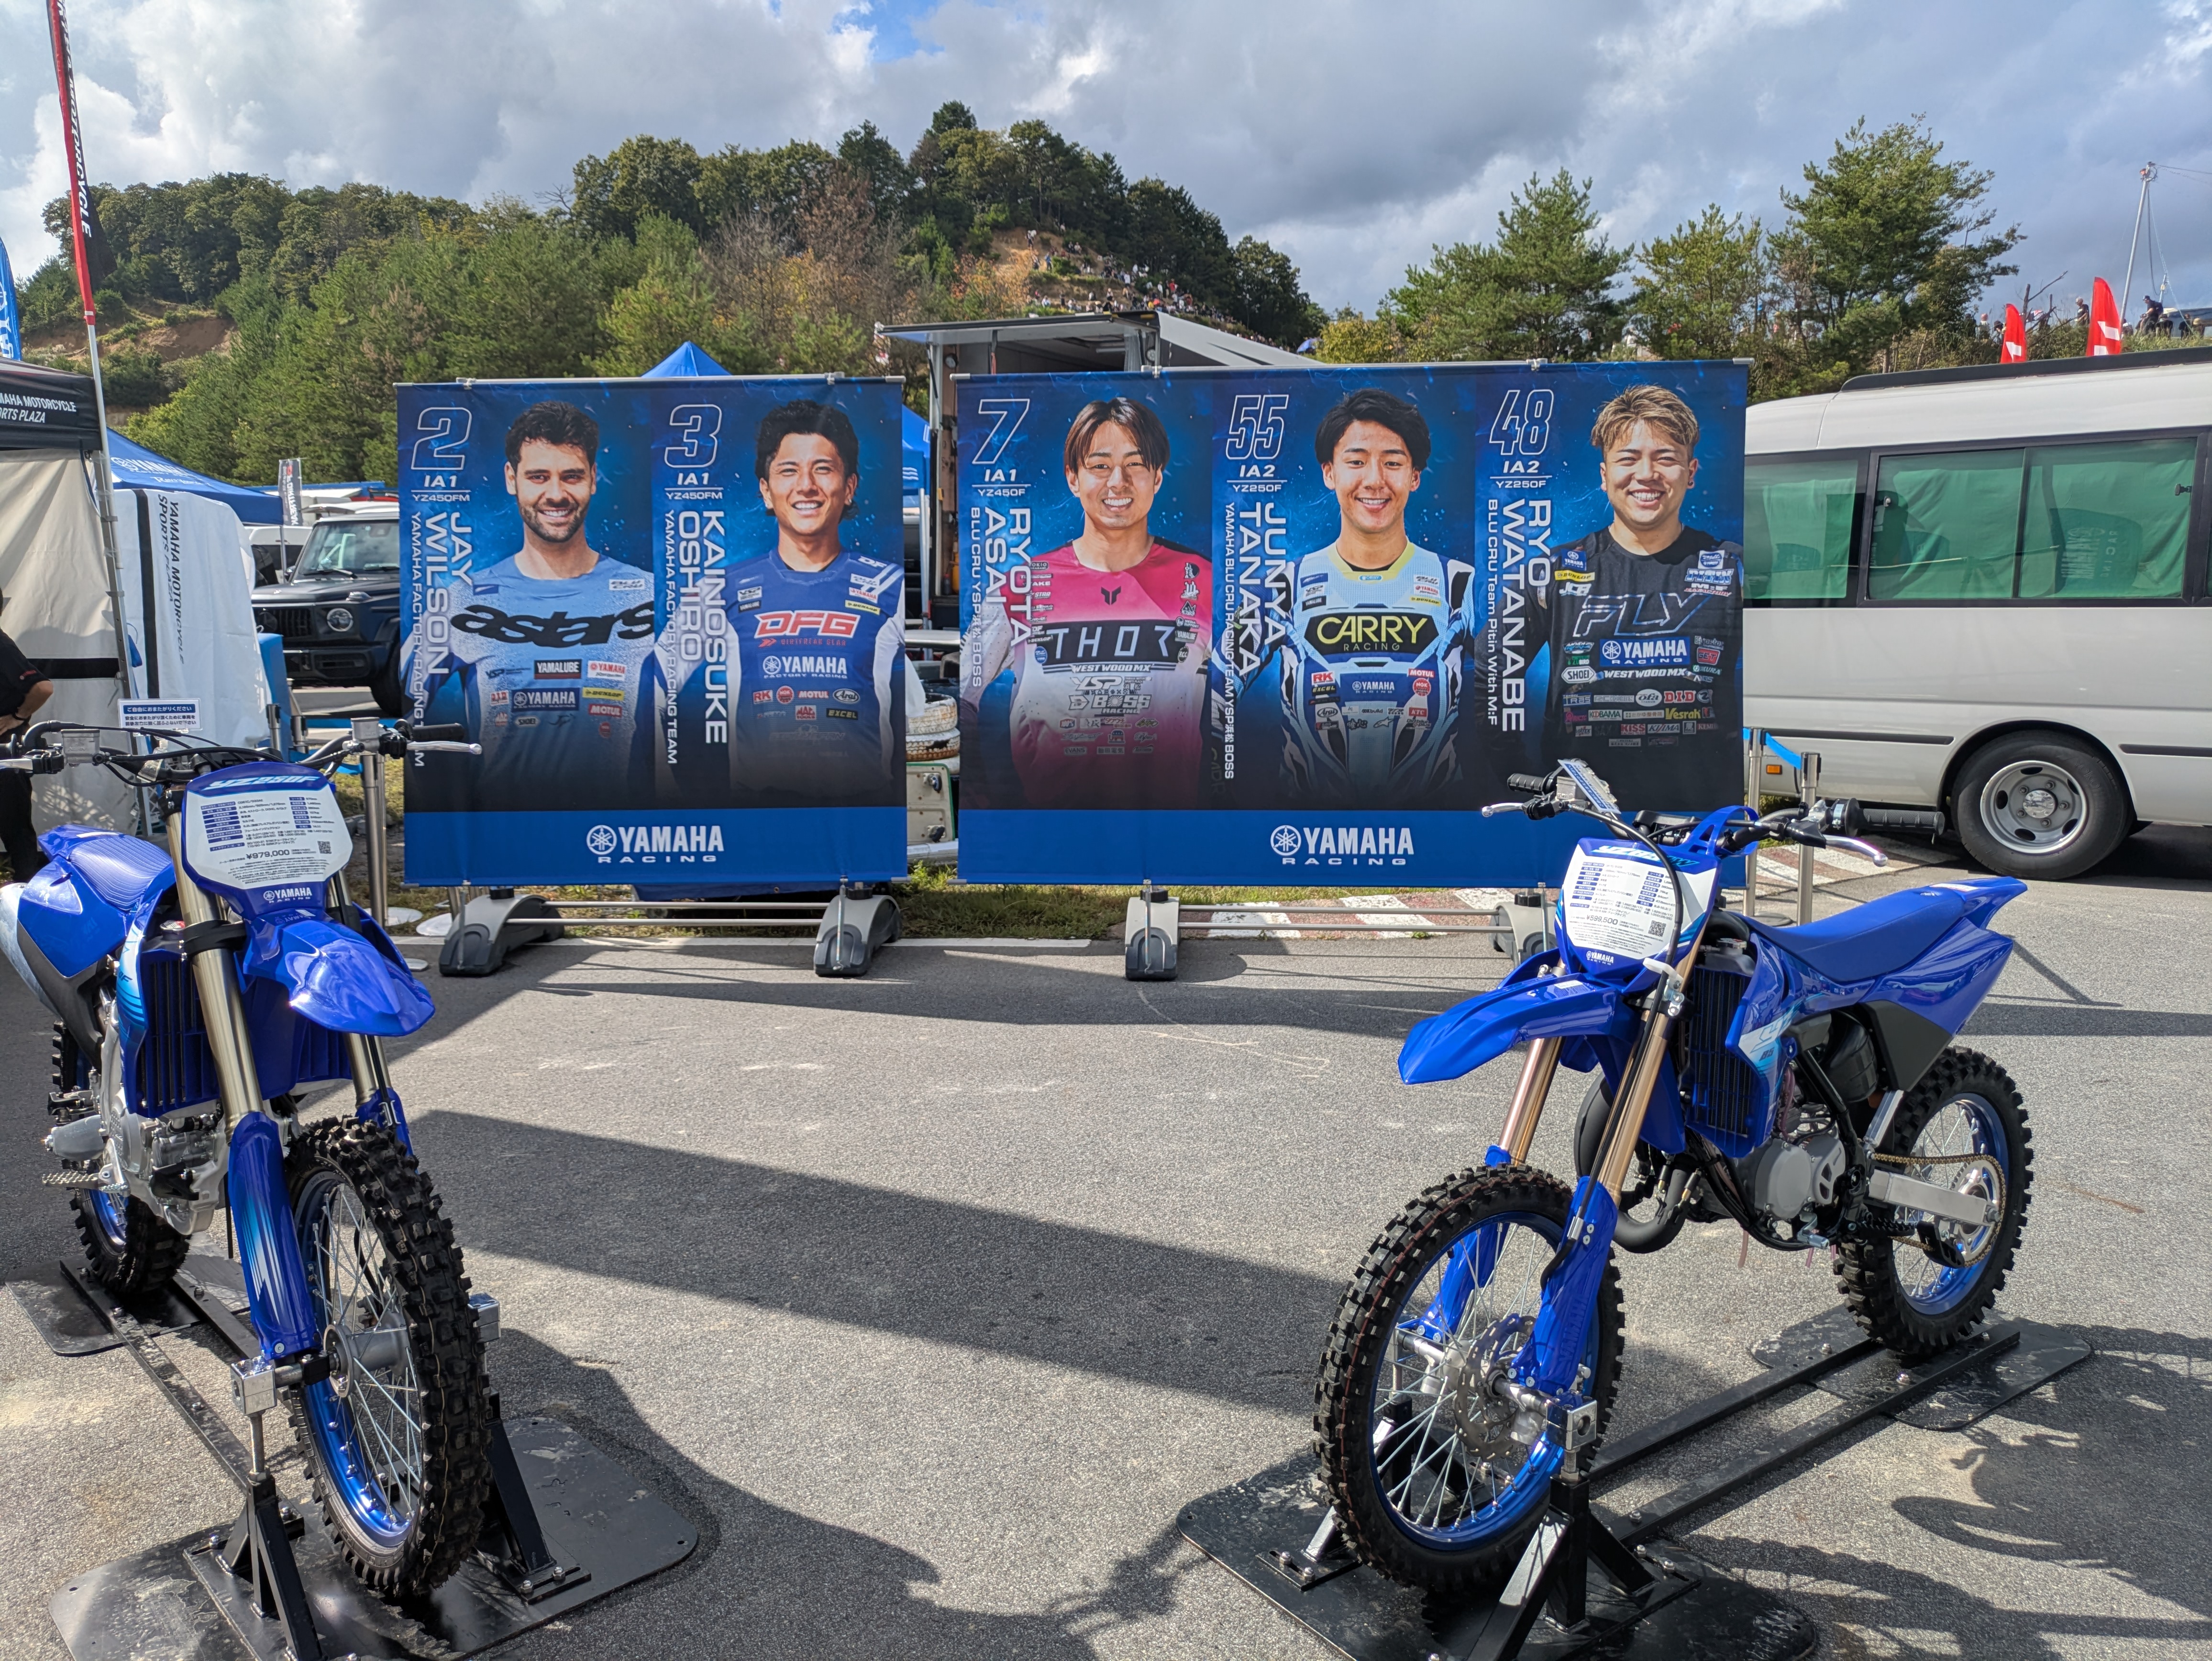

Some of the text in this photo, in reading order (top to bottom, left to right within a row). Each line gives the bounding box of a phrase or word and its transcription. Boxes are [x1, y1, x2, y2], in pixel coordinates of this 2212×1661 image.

[69, 76, 91, 238] MOTORCYCLE
[19, 410, 46, 423] PLAZA
[22, 396, 77, 412] MOTORCYCLE
[972, 399, 1030, 465] 7
[1226, 395, 1289, 460] 55
[1489, 389, 1554, 456] 48
[411, 407, 473, 470] 2
[664, 404, 722, 468] 3
[677, 473, 709, 485] IA1
[984, 469, 1017, 482] IA1
[1239, 465, 1276, 477] IA2
[1503, 461, 1539, 473] IA2
[424, 476, 457, 488] IA1
[978, 488, 1026, 497] YZ450F
[1496, 480, 1547, 488] YZ250F
[412, 494, 471, 502] YZ450FM
[666, 492, 723, 500] YZ450FM
[971, 507, 981, 540] BLU
[1225, 502, 1235, 555] YAMAHA
[158, 494, 173, 602] SPORTS PLAZA
[450, 512, 474, 586] JAY
[984, 507, 1007, 603] ASAI
[1528, 499, 1551, 586] RYO
[858, 557, 887, 568] DF
[971, 544, 981, 578] CRU
[1225, 558, 1235, 583] BLU
[1264, 502, 1287, 645] JUNYA
[1564, 558, 1583, 566] YAMAHA
[170, 501, 184, 664] YAMAHA MOTORCYCLE
[679, 510, 702, 661] OSHIRO
[1009, 508, 1032, 646] RYOTA
[1239, 502, 1261, 676] TANAKA
[425, 512, 449, 674] WILSON
[1225, 585, 1235, 610] CRU
[754, 610, 861, 638] DFG
[1488, 499, 1498, 725] BLU CRU Team Pitin With M:F
[1502, 498, 1525, 731] WATANABE
[1572, 592, 1714, 637] FLY
[411, 511, 425, 767] YAMAHA FACTORY RACING TM
[665, 509, 678, 764] YAMAHA FACTORY RACING TEAM
[703, 510, 728, 744] KAINOSUKE
[1225, 613, 1235, 663] RACING
[1316, 615, 1428, 644] CARRY
[1046, 626, 1176, 659] THOR
[1344, 643, 1400, 652] RACING
[1622, 639, 1687, 659] YAMAHA
[537, 661, 580, 673] YAMALUBE
[782, 656, 847, 675] YAMAHA
[972, 642, 982, 687] BOSS
[1698, 652, 1717, 661] GET
[1070, 675, 1123, 691] YSP
[1225, 664, 1234, 697] TEAM
[1313, 672, 1334, 681] RK
[1362, 681, 1395, 690] YAMAHA
[1567, 670, 1590, 680] SHOEI
[527, 691, 576, 704] YAMAHA
[753, 691, 771, 701] RK
[798, 690, 829, 699] MOTUL
[837, 690, 856, 700] Arai
[590, 706, 621, 716] MOTUL
[828, 709, 857, 719] EXCEL
[1665, 708, 1701, 720] Vesrah
[1621, 724, 1646, 732] KISS
[1225, 744, 1234, 779] BOSS
[618, 826, 725, 853] YAMAHA
[1303, 827, 1415, 855] YAMAHA
[246, 849, 290, 860] ¥979,000
[275, 887, 312, 899] YAMAHA
[1586, 914, 1618, 925] ¥599,500
[1591, 952, 1614, 964] YAMAHA
